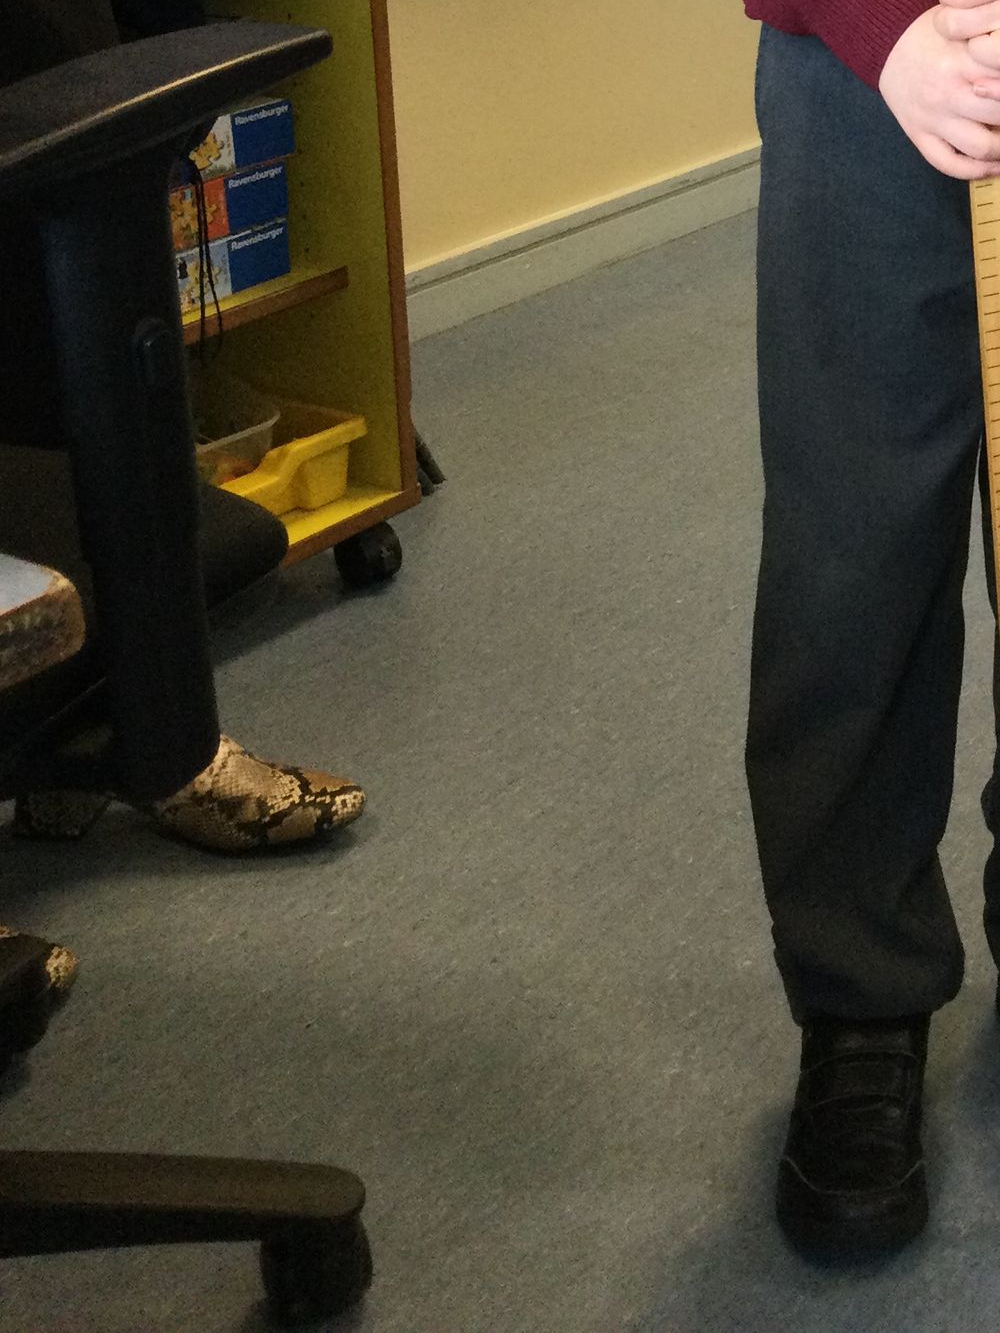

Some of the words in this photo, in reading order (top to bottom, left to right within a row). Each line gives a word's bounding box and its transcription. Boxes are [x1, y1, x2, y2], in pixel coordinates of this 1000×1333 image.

[235, 104, 289, 126] Ravensburger
[228, 166, 282, 189] Ravensburger
[231, 226, 284, 251] Ravensburger
